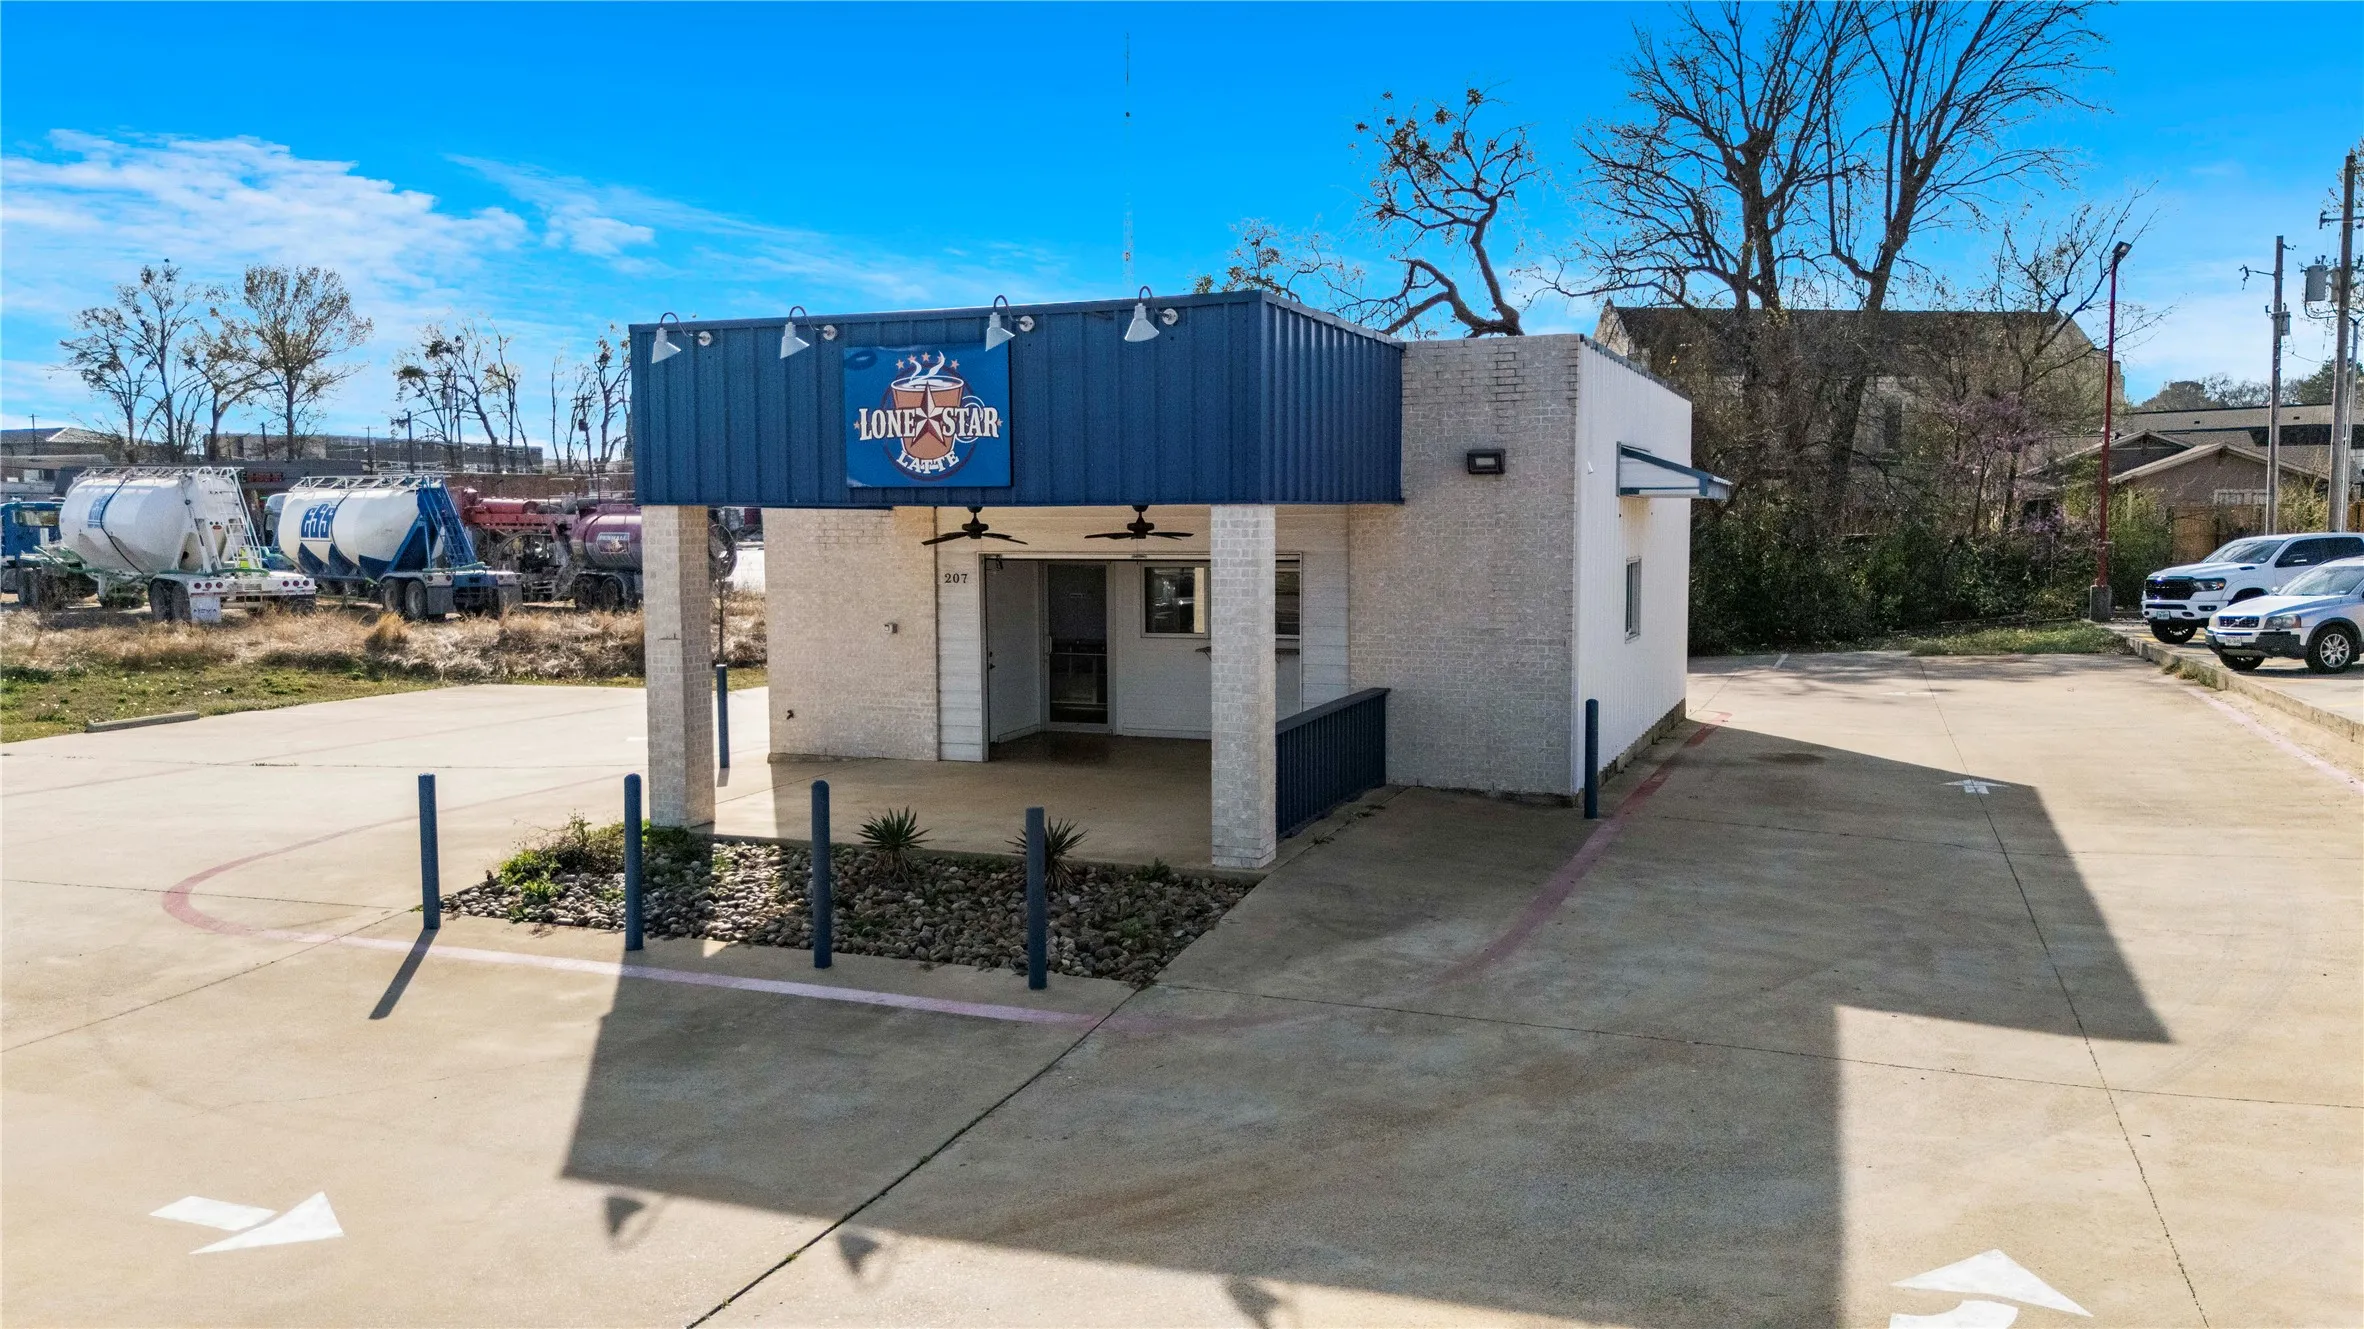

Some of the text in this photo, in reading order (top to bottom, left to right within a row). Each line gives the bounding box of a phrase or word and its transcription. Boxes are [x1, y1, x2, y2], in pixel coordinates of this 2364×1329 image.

[858, 407, 1000, 441] LONE STAR
[896, 450, 960, 474] LATTE
[944, 572, 968, 584] 207
